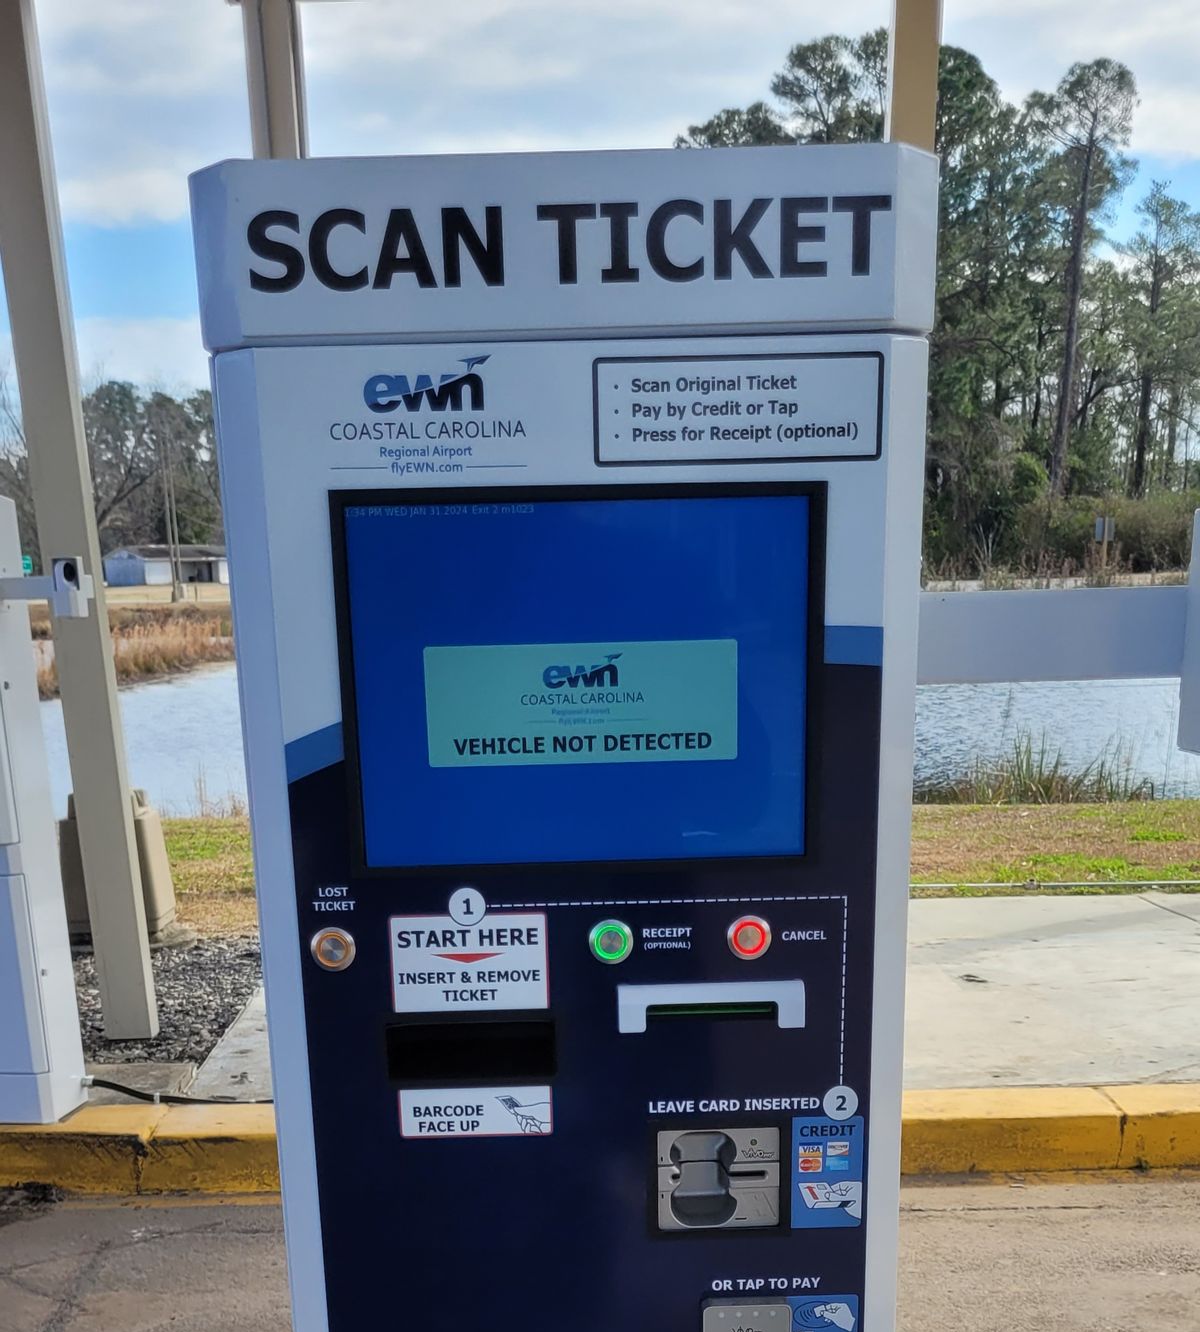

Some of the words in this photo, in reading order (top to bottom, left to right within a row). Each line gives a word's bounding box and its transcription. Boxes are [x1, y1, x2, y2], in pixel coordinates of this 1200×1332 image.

[246, 206, 504, 293] SCAN
[536, 194, 892, 284] TICKET
[363, 372, 485, 414] ewn
[631, 378, 671, 393] Scan
[676, 375, 741, 395] Original
[746, 375, 798, 391] Ticket
[632, 402, 662, 420] Pay
[667, 402, 686, 420] by
[691, 400, 742, 417] Credit
[749, 402, 764, 416] or
[768, 400, 799, 417] Tap
[330, 422, 420, 441] COASTAL
[425, 420, 527, 439] CAROLINA
[632, 427, 677, 442] Press
[681, 426, 705, 441] for
[710, 425, 772, 443] Receipt
[776, 422, 859, 443] (optional)
[379, 446, 430, 461] Regional
[432, 445, 473, 460] Airport
[391, 461, 463, 476] flyEWN.com
[368, 507, 383, 517] PM
[384, 507, 408, 517] WED
[409, 506, 427, 518] JAN
[471, 504, 490, 515] Exit
[542, 663, 619, 689] ewn
[521, 693, 578, 706] COASTAL
[580, 691, 645, 704] CAROLINA
[454, 736, 545, 756] VEHICLE
[553, 735, 597, 753] NOT
[604, 731, 712, 752] DETECTED
[318, 887, 349, 897] LOST
[312, 900, 356, 912] TICKET
[462, 898, 474, 916] 1
[397, 929, 471, 949] START
[479, 927, 539, 947] HERE
[642, 927, 692, 938] RECEIPT
[781, 930, 827, 941] CANCEL
[643, 941, 691, 950] (OPTIONAL)
[398, 971, 456, 985] INSERT
[461, 971, 472, 983] &
[477, 969, 541, 983] REMOVE
[442, 988, 498, 1002] TICKET
[649, 1100, 695, 1114] LEAVE
[699, 1099, 740, 1112] CARD
[744, 1097, 820, 1111] INSERTED
[835, 1095, 847, 1111] 2
[413, 1105, 484, 1118] BARCODE
[419, 1120, 455, 1133] FACE
[460, 1120, 480, 1132] UP
[800, 1125, 856, 1137] CREDIT
[711, 1280, 733, 1291] OR
[736, 1278, 764, 1290] TAP
[768, 1278, 788, 1290] TO
[792, 1276, 821, 1289] PAY
